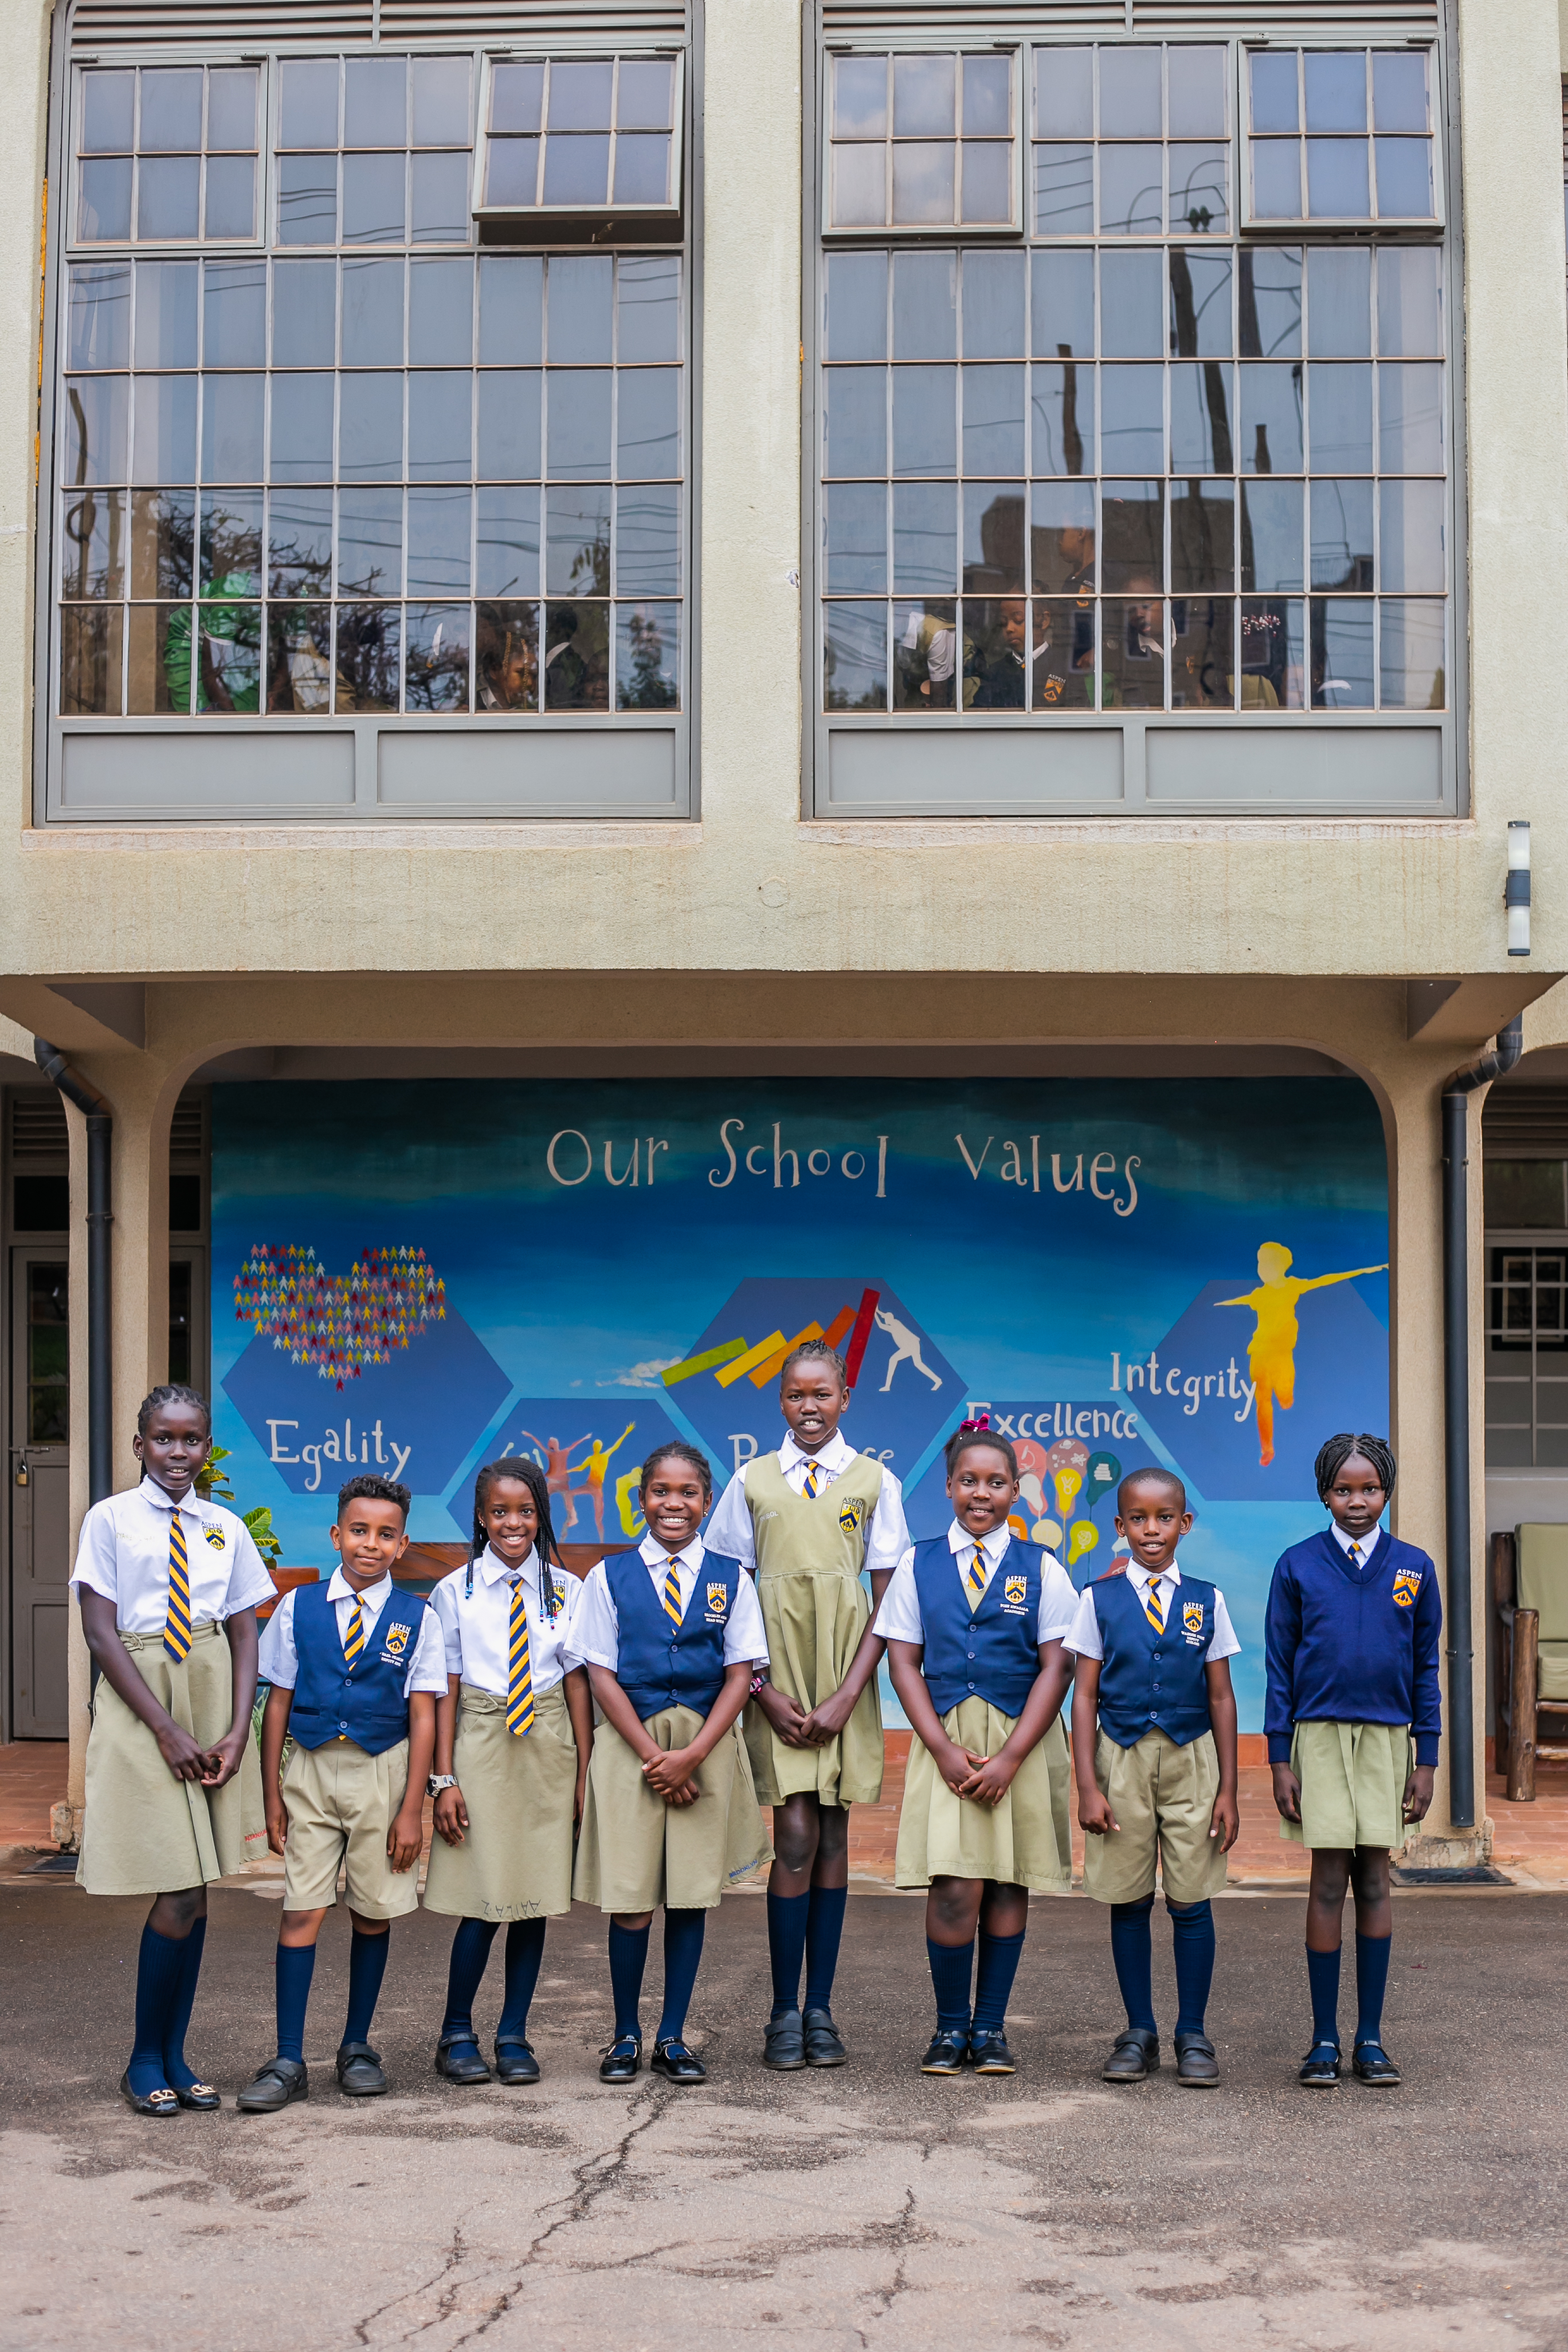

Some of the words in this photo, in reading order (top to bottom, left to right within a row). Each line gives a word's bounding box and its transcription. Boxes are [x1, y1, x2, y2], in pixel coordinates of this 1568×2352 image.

[1048, 673, 1066, 683] ASPEN
[547, 1130, 668, 1186] Our
[708, 1119, 889, 1198] School
[955, 1134, 1141, 1217] Values
[1110, 1351, 1256, 1422] Integrity
[265, 1418, 411, 1491] Egality
[842, 1497, 864, 1507] ASPEN
[1397, 1569, 1422, 1579] ASPEN
[390, 1621, 411, 1632] ASPEN
[728, 1859, 758, 1878] BROOKLYN
